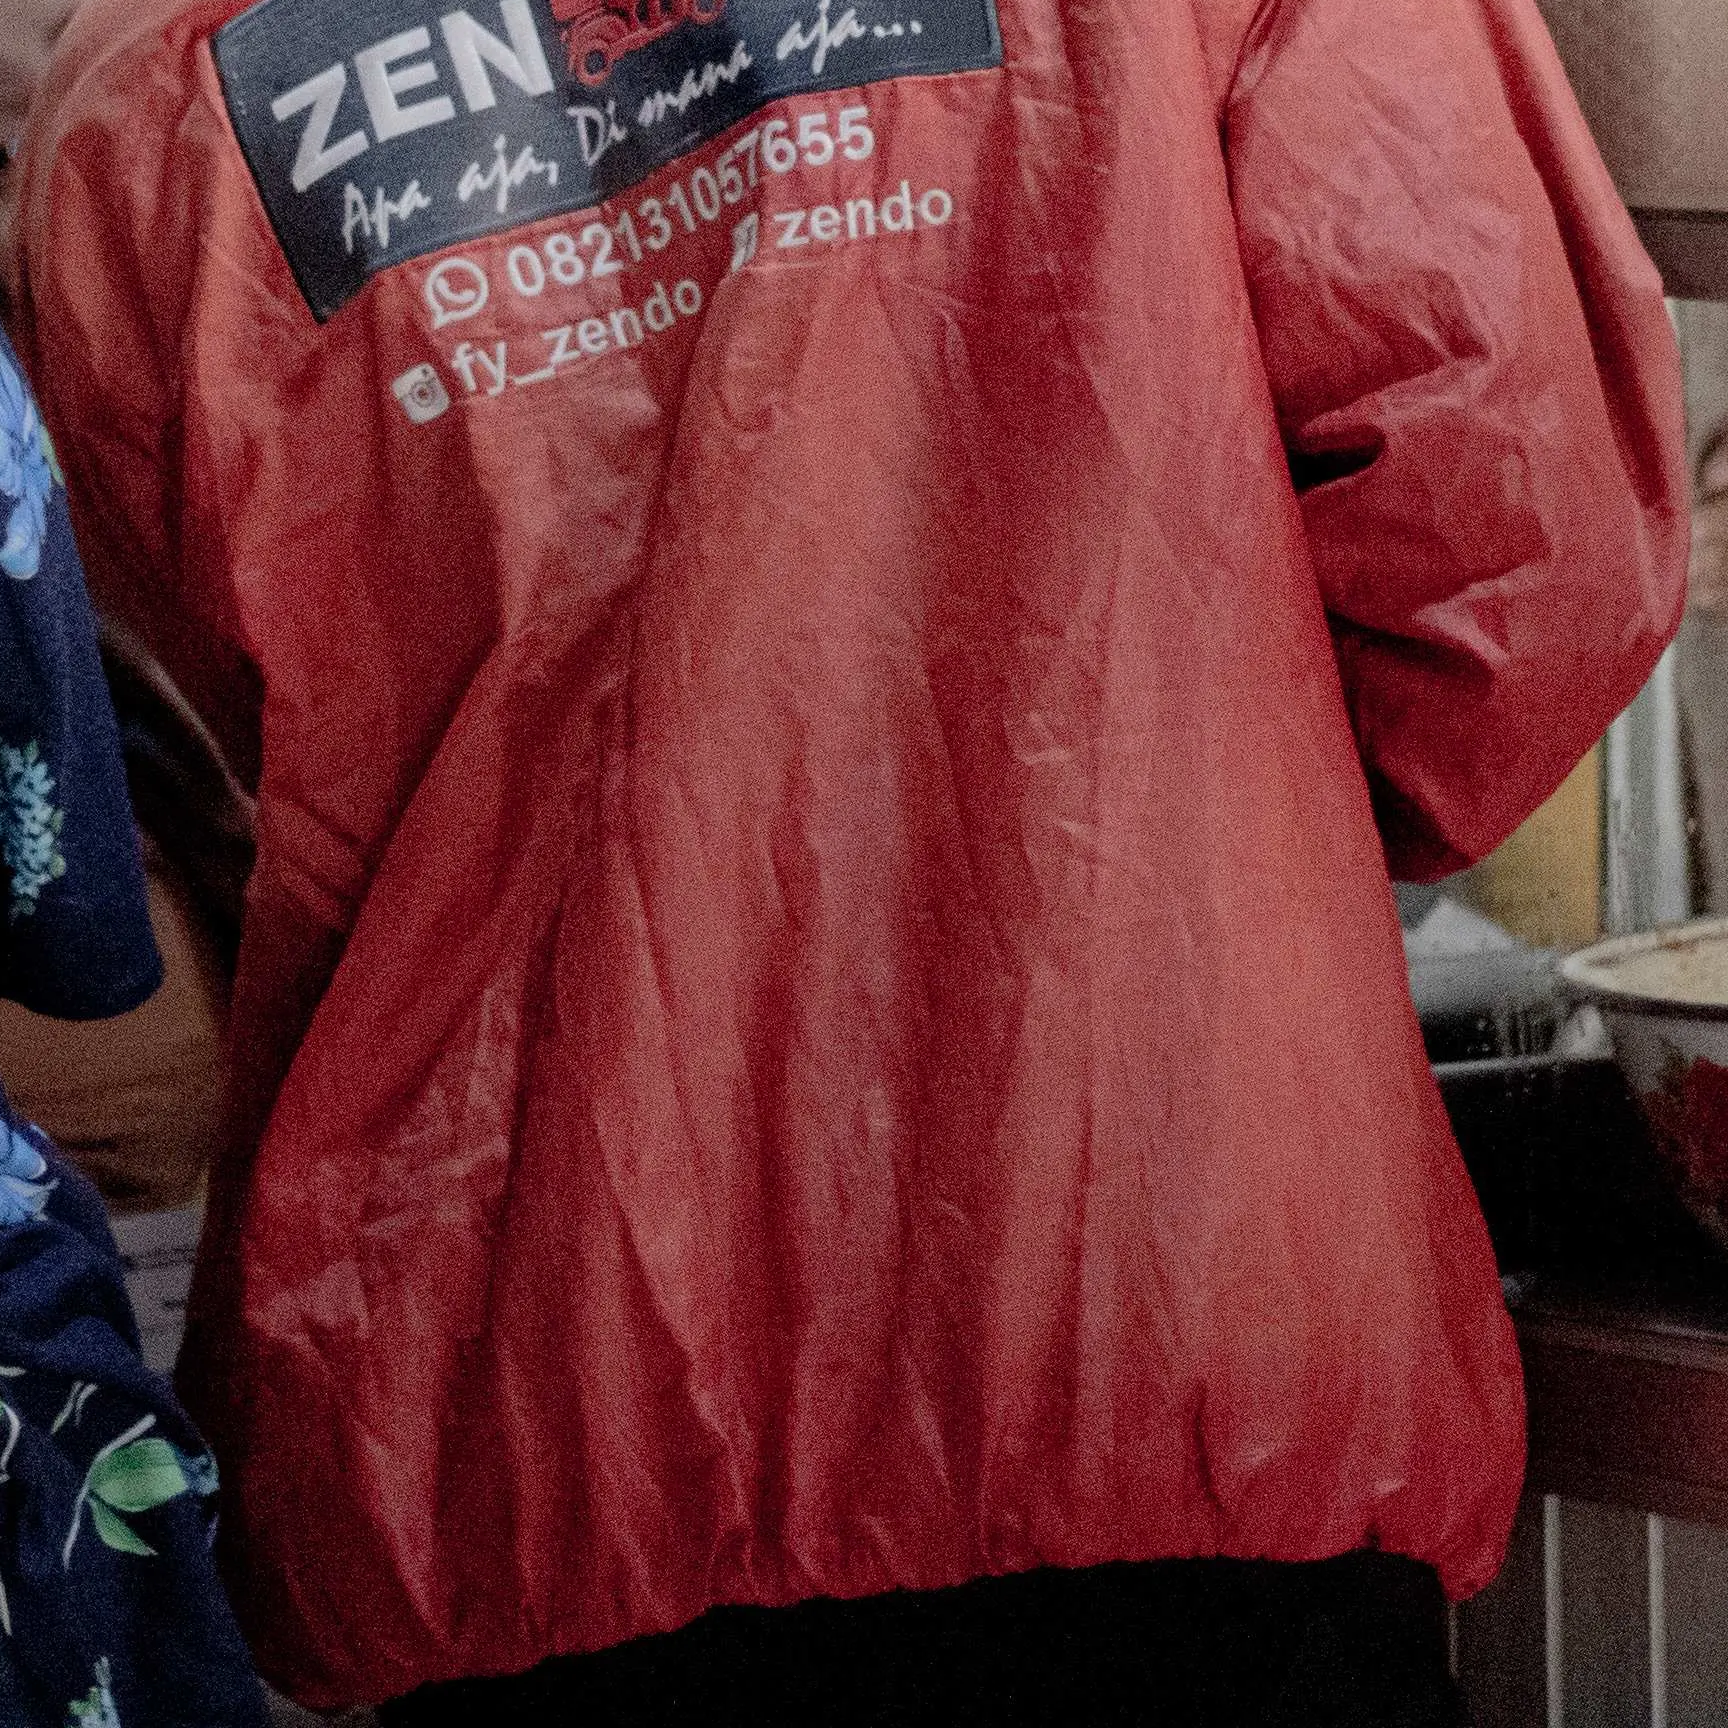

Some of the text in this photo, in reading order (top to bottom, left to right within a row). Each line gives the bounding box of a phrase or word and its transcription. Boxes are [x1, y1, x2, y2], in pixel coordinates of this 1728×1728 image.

[342, 181, 432, 255] Apa
[566, 99, 629, 167] Di
[637, 38, 753, 128] mana
[506, 104, 875, 298] 082131057655
[451, 179, 954, 397] fy_zendo zendo
